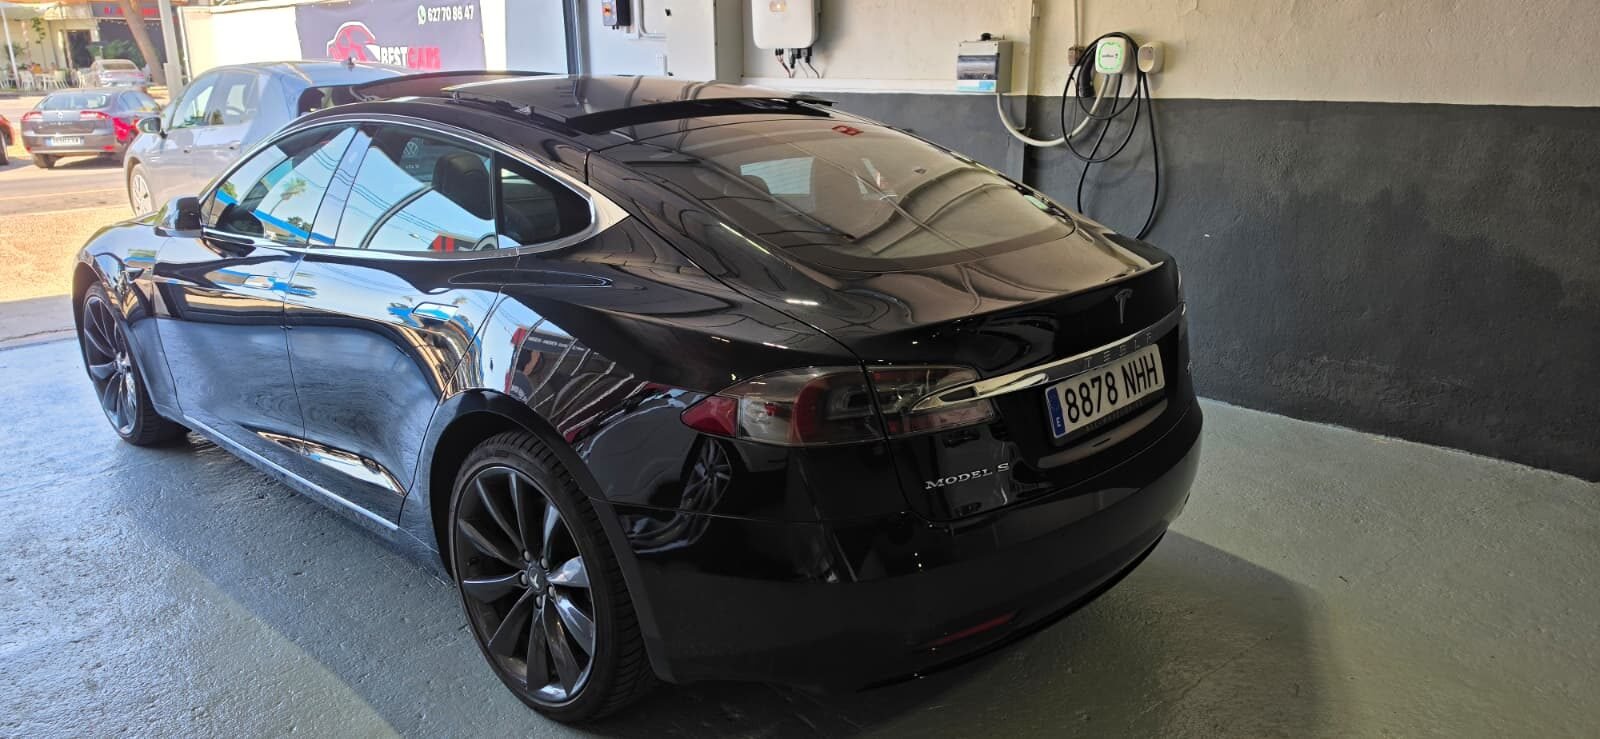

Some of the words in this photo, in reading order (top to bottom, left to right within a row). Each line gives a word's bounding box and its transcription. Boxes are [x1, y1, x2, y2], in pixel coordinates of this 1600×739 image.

[428, 7, 441, 22] 627
[441, 6, 451, 21] 70
[464, 5, 474, 20] 47
[1065, 371, 1118, 423] 8878
[1121, 353, 1158, 398] NHH
[925, 469, 992, 489] MODEL
[997, 462, 1009, 472] S
